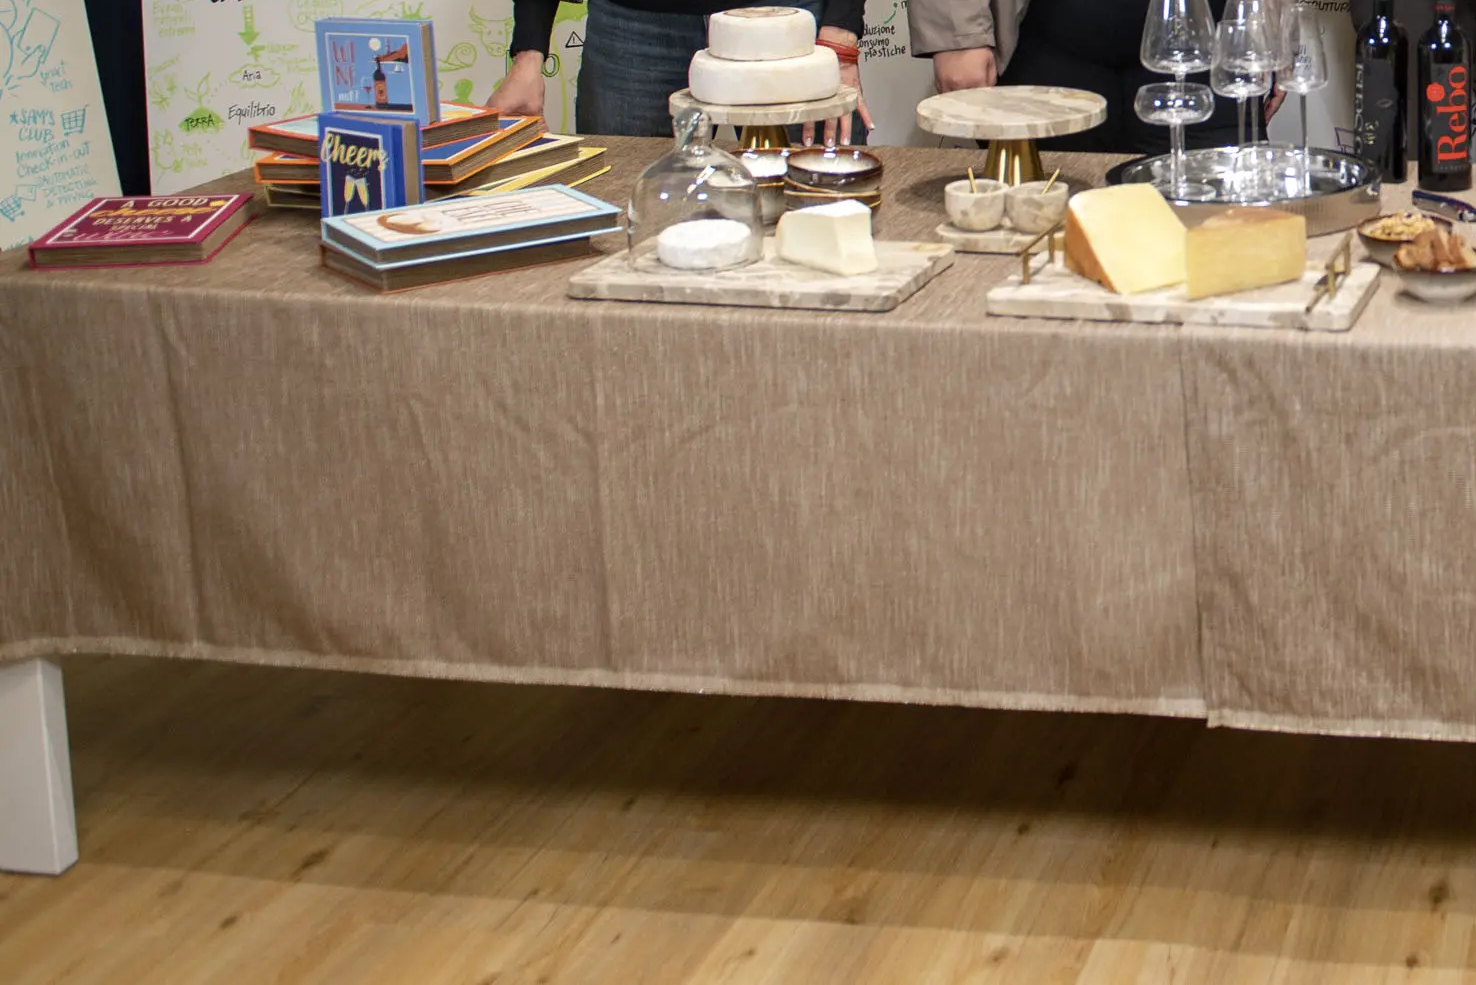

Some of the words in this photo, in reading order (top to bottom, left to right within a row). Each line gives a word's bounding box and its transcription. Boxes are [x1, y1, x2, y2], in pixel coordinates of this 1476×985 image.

[228, 104, 276, 121] Equilibrio
[1436, 65, 1468, 165] Rebo
[321, 132, 389, 172] Cheers
[147, 198, 208, 207] GOOD
[93, 215, 173, 225] DESERVES
